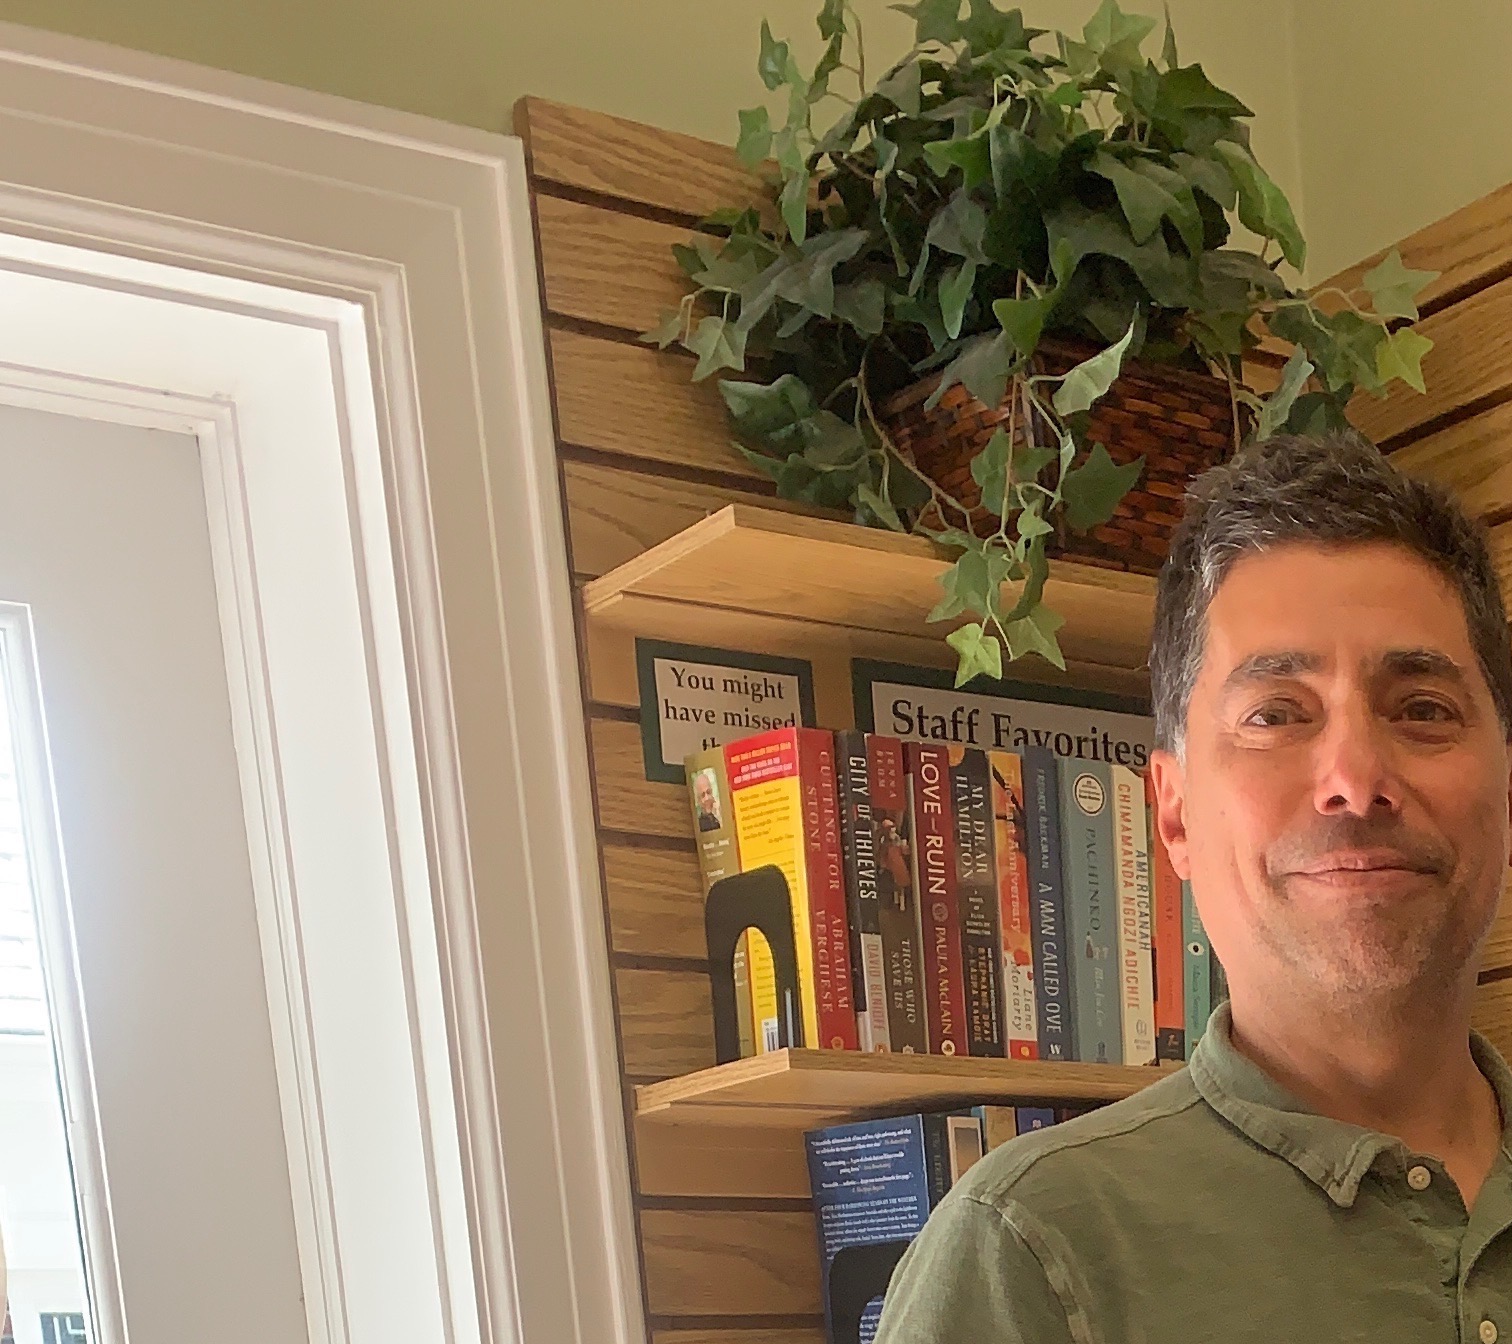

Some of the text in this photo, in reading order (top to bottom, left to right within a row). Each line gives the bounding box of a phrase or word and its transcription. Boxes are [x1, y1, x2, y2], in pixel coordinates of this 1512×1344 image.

[664, 698, 796, 730] have missed
[670, 667, 785, 703] You might
[892, 699, 1148, 767] Staff Favorites
[807, 785, 822, 852] STONE
[818, 751, 841, 890] CUTTING FOR
[850, 756, 878, 900] CITY OF THIEVES
[920, 751, 948, 896] LOVE RUIN
[955, 775, 974, 879] HAMILTON
[1004, 769, 1016, 797] The
[971, 784, 989, 874] MY DEAR
[1008, 840, 1022, 934] Anniversary
[1085, 827, 1101, 931] PACHINKO
[1117, 783, 1140, 1010] CHIMAMANDA NGOZI ADICHIE
[1135, 850, 1151, 951] AMERICANAH
[815, 909, 834, 1013] VERGHESE
[831, 914, 850, 1009] ABRAHAM
[867, 943, 882, 978] DAVID
[891, 951, 904, 1010] SAVE US
[901, 939, 917, 1024] THOSE WHO
[935, 926, 949, 974] PAULA
[1039, 882, 1063, 1034] A MAN CALLED OVE
[1010, 960, 1022, 1031] Moriarty
[1023, 987, 1033, 1031] Liane
